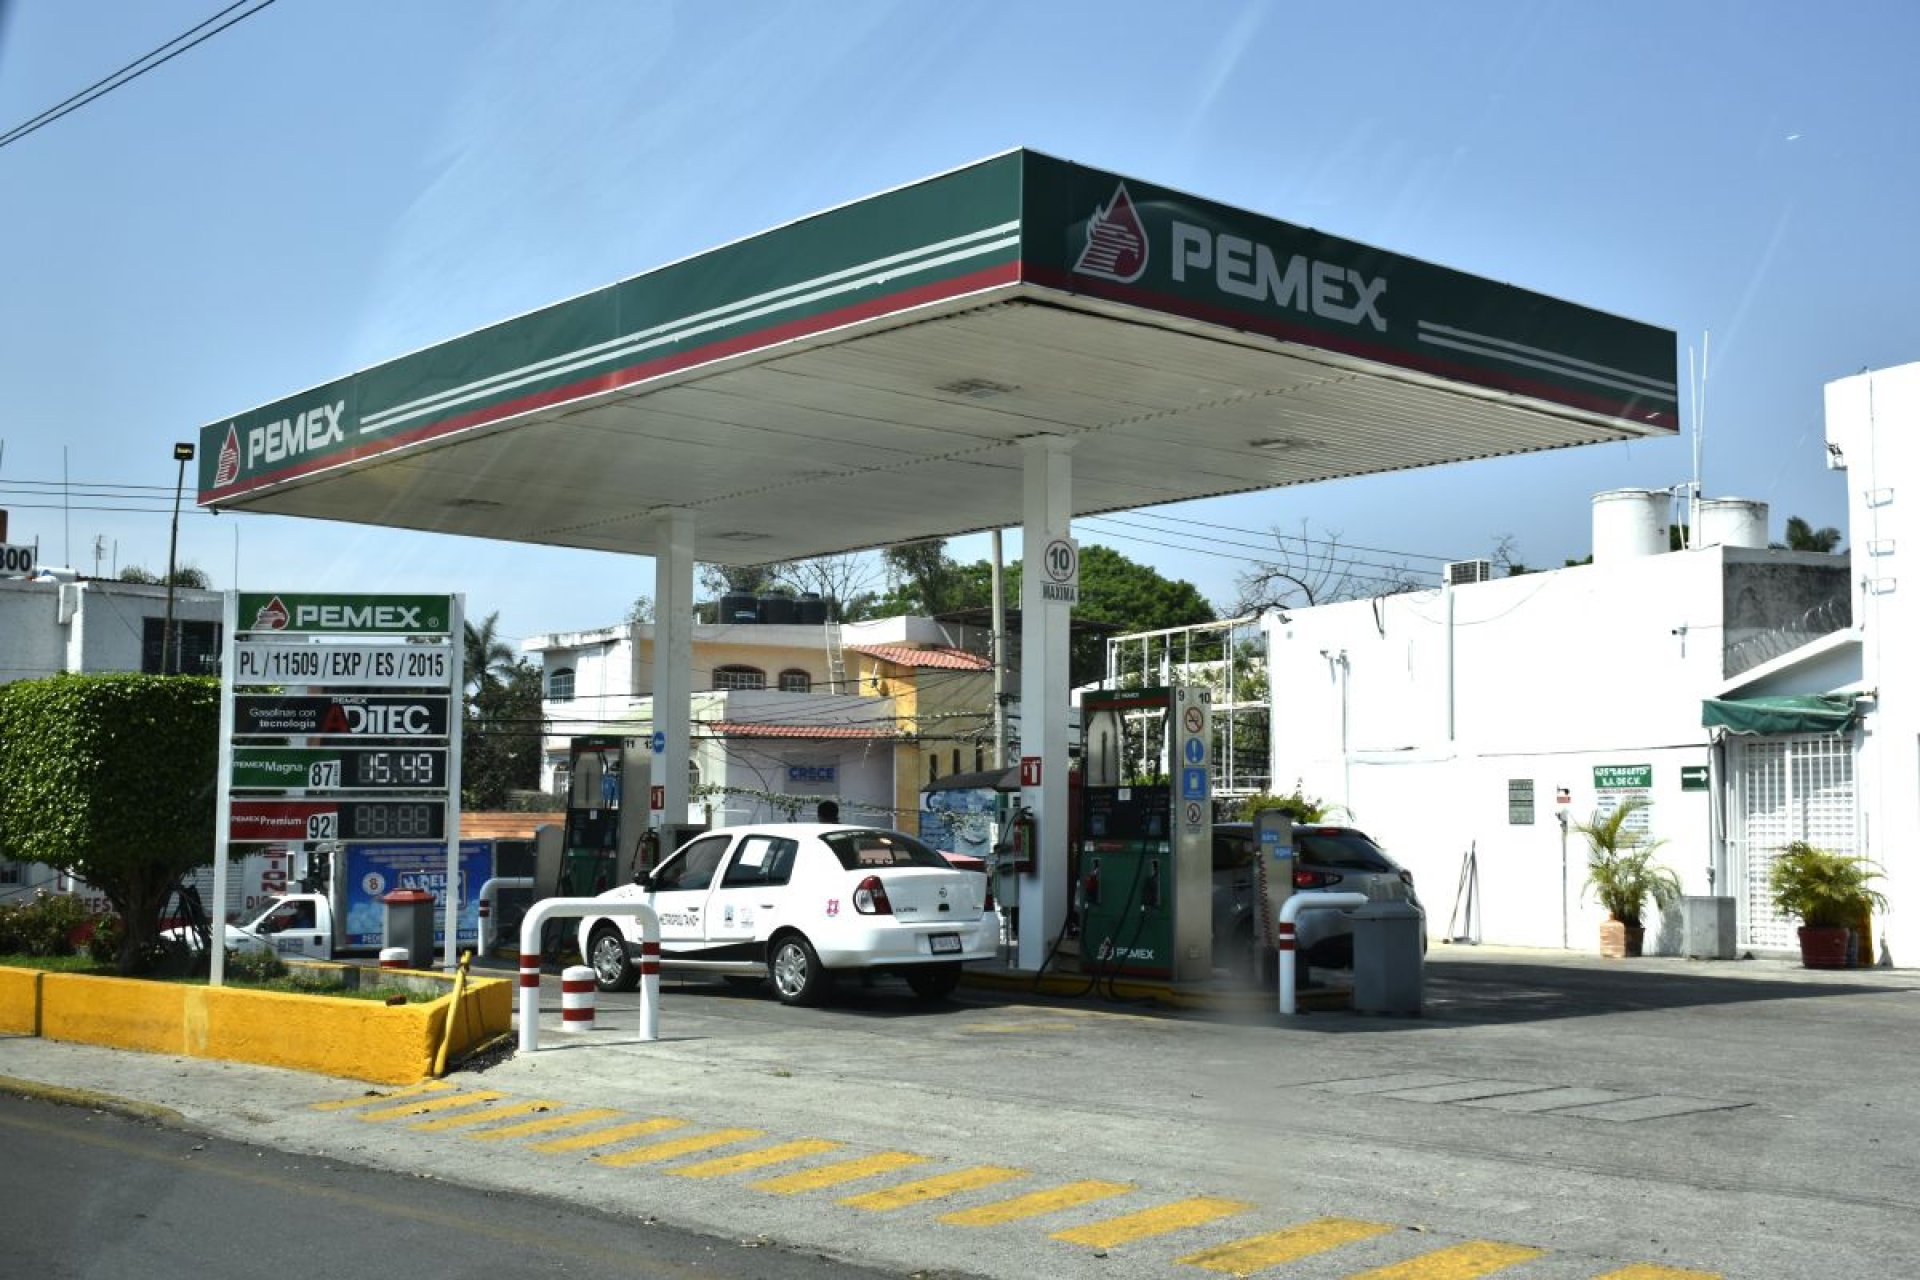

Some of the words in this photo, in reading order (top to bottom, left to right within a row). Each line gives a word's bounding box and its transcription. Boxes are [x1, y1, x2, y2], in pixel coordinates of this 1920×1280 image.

[1172, 220, 1387, 332] PEMEX
[247, 400, 345, 469] PEMEX
[1049, 547, 1070, 570] 10
[296, 606, 421, 628] PEMEX
[1199, 692, 1211, 704] 10
[249, 707, 298, 718] Gasolinas
[299, 708, 316, 718] con
[264, 761, 303, 775] Magna
[312, 763, 334, 787] 87
[260, 815, 302, 825] Premium
[309, 815, 331, 839] 92
